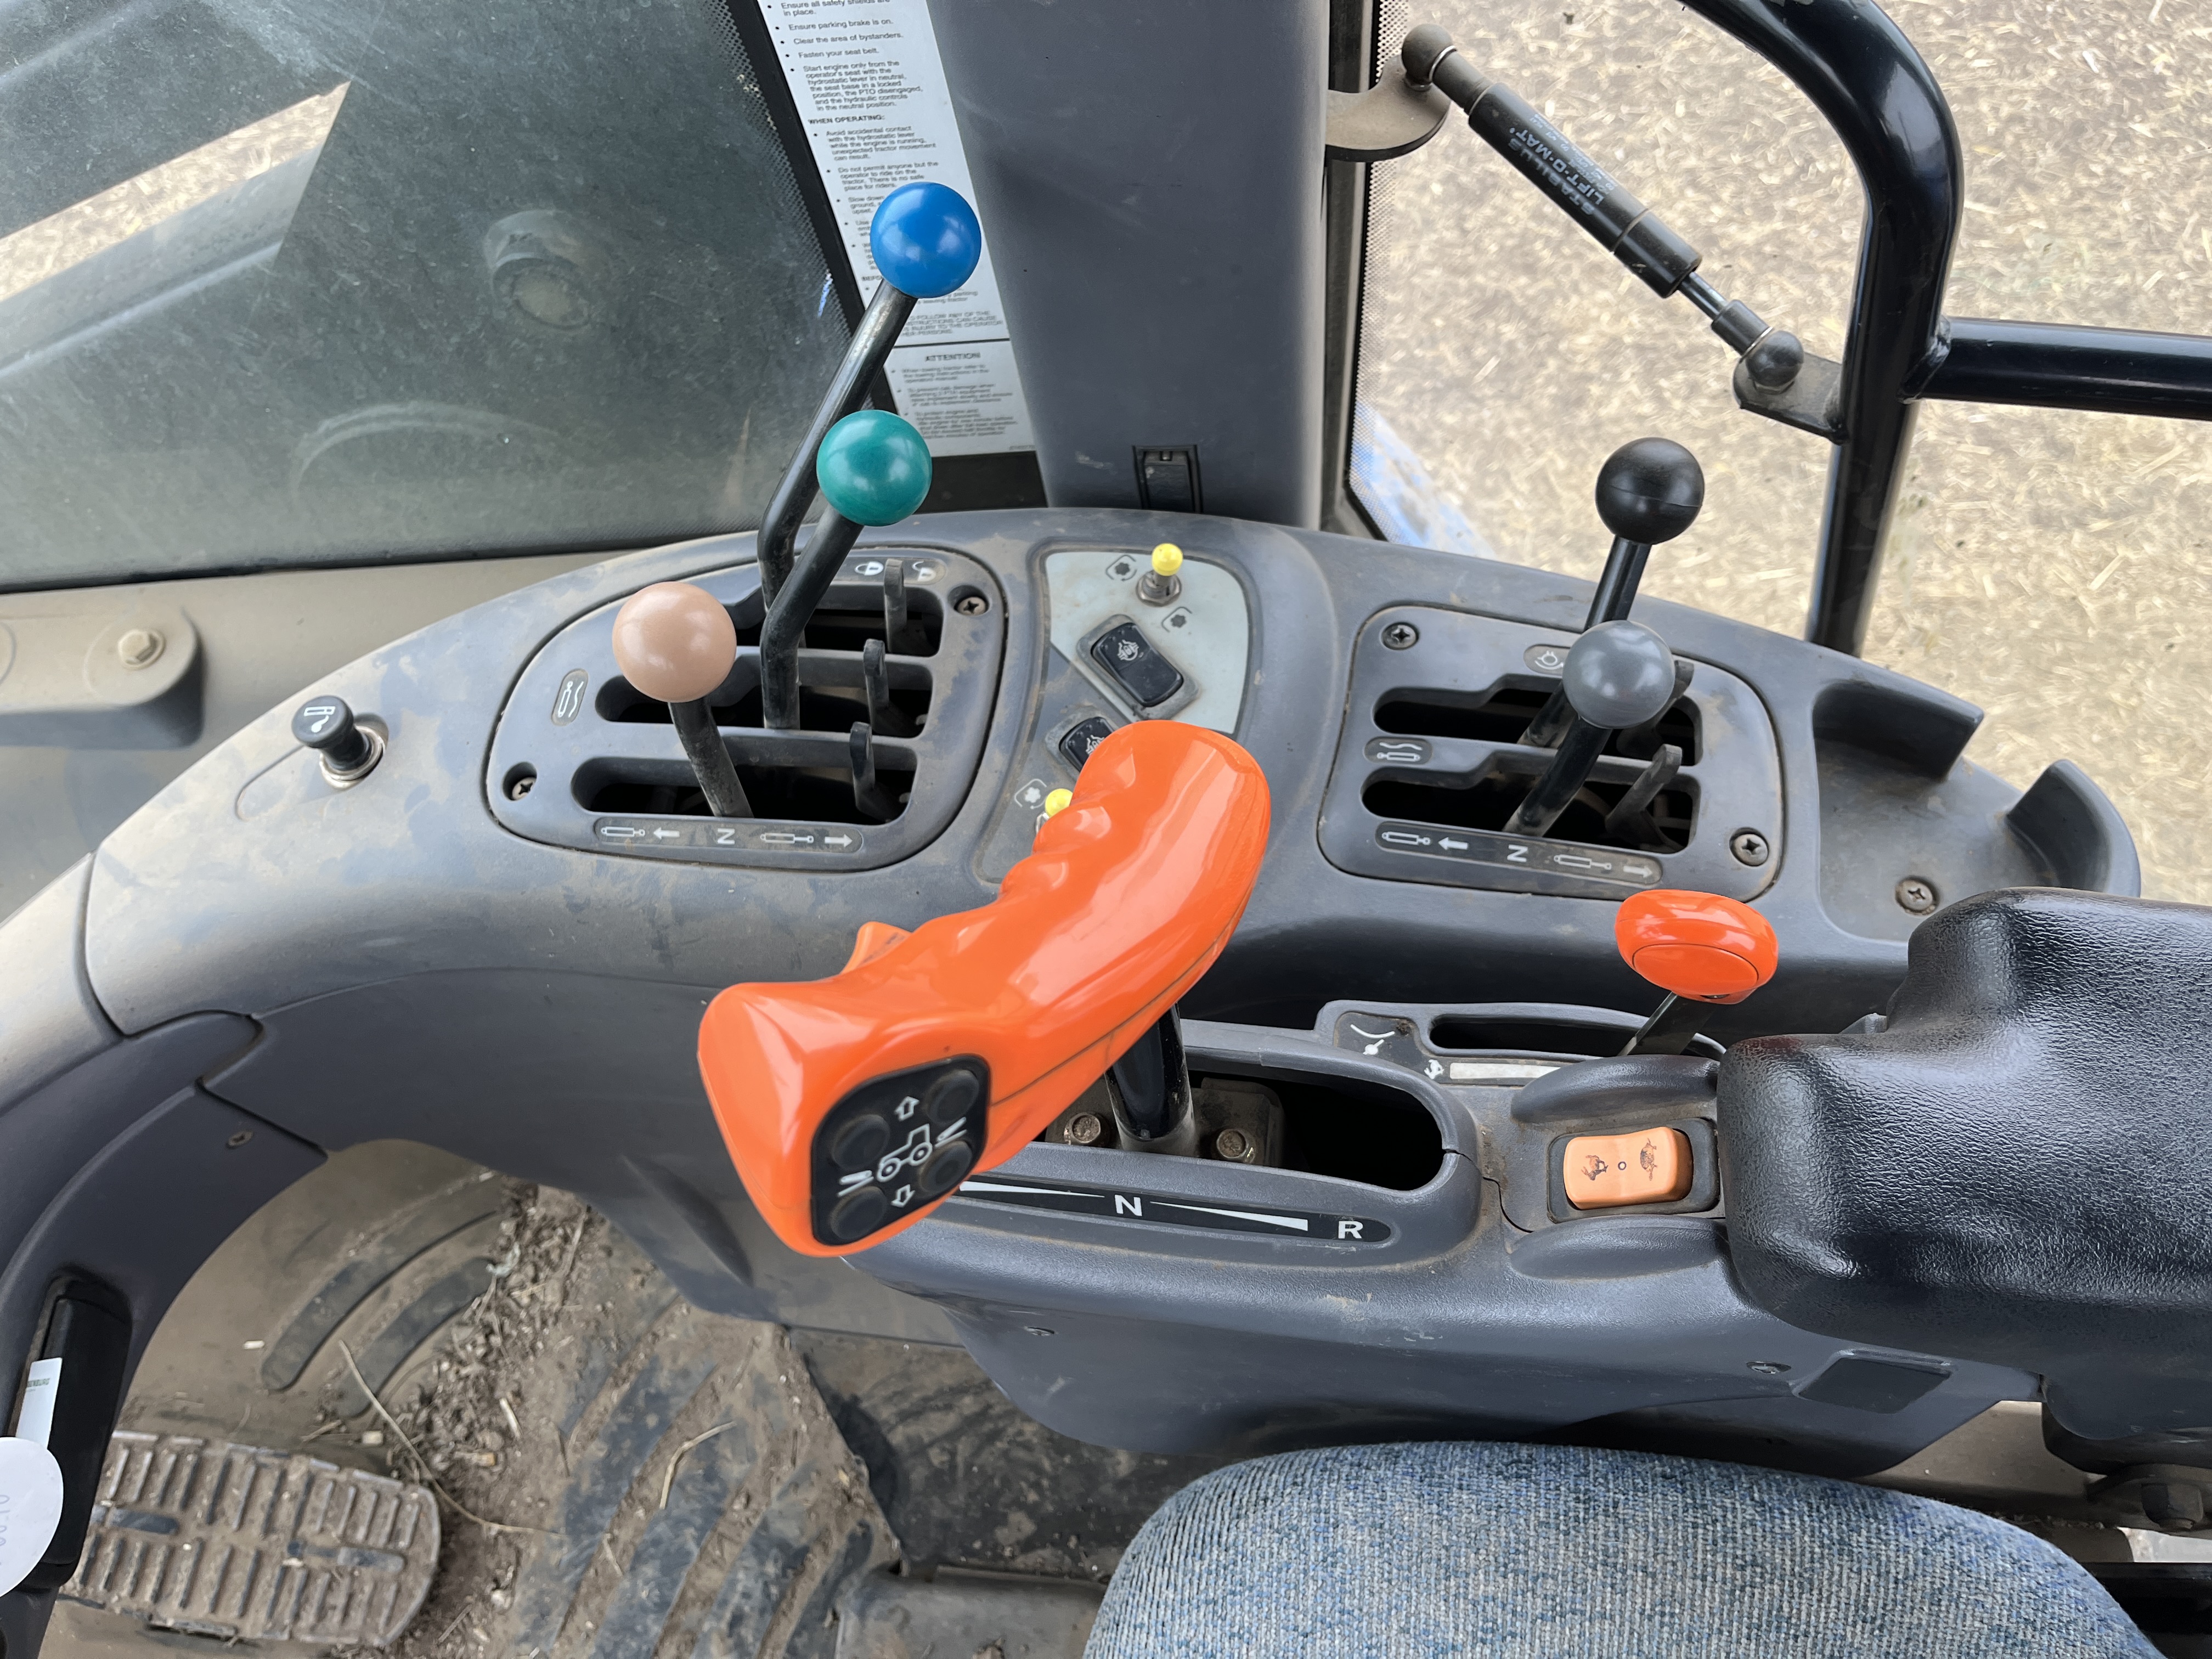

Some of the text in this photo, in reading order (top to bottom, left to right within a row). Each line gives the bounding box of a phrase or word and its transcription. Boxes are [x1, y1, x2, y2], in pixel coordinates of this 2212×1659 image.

[859, 32, 903, 41] bystanders.
[808, 77, 848, 86] hydrostatic
[812, 91, 842, 99] position,
[877, 86, 923, 95] disengaged,
[843, 95, 877, 104] hydraulic
[834, 114, 885, 122] OPERATING:
[1509, 138, 1595, 215] STABILUS
[925, 352, 981, 362] ATTENTION
[1115, 1194, 1142, 1216] N
[1338, 1221, 1363, 1239] R
